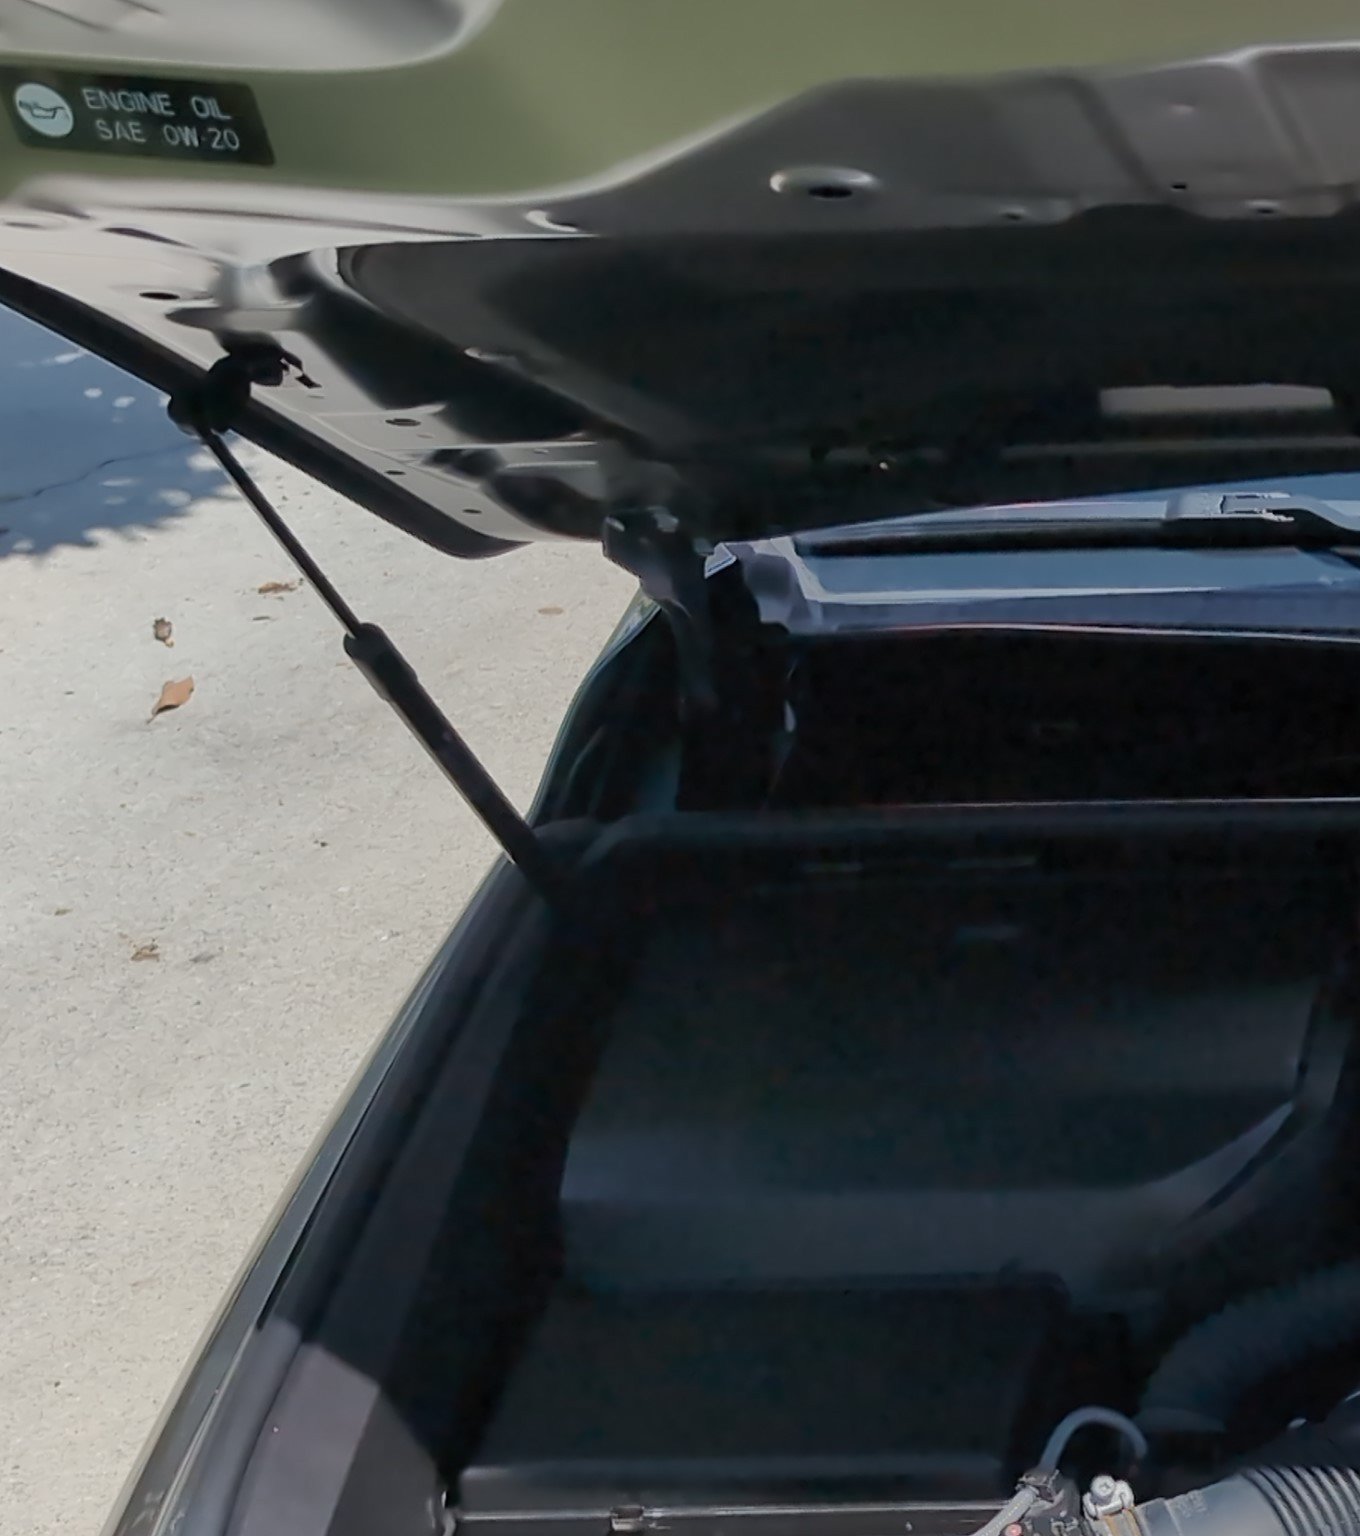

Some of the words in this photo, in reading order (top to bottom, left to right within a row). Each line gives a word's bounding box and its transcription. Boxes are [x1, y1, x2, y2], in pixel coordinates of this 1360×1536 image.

[82, 88, 176, 117] ENGINE
[191, 96, 232, 120] OIL
[97, 120, 147, 143] SAE
